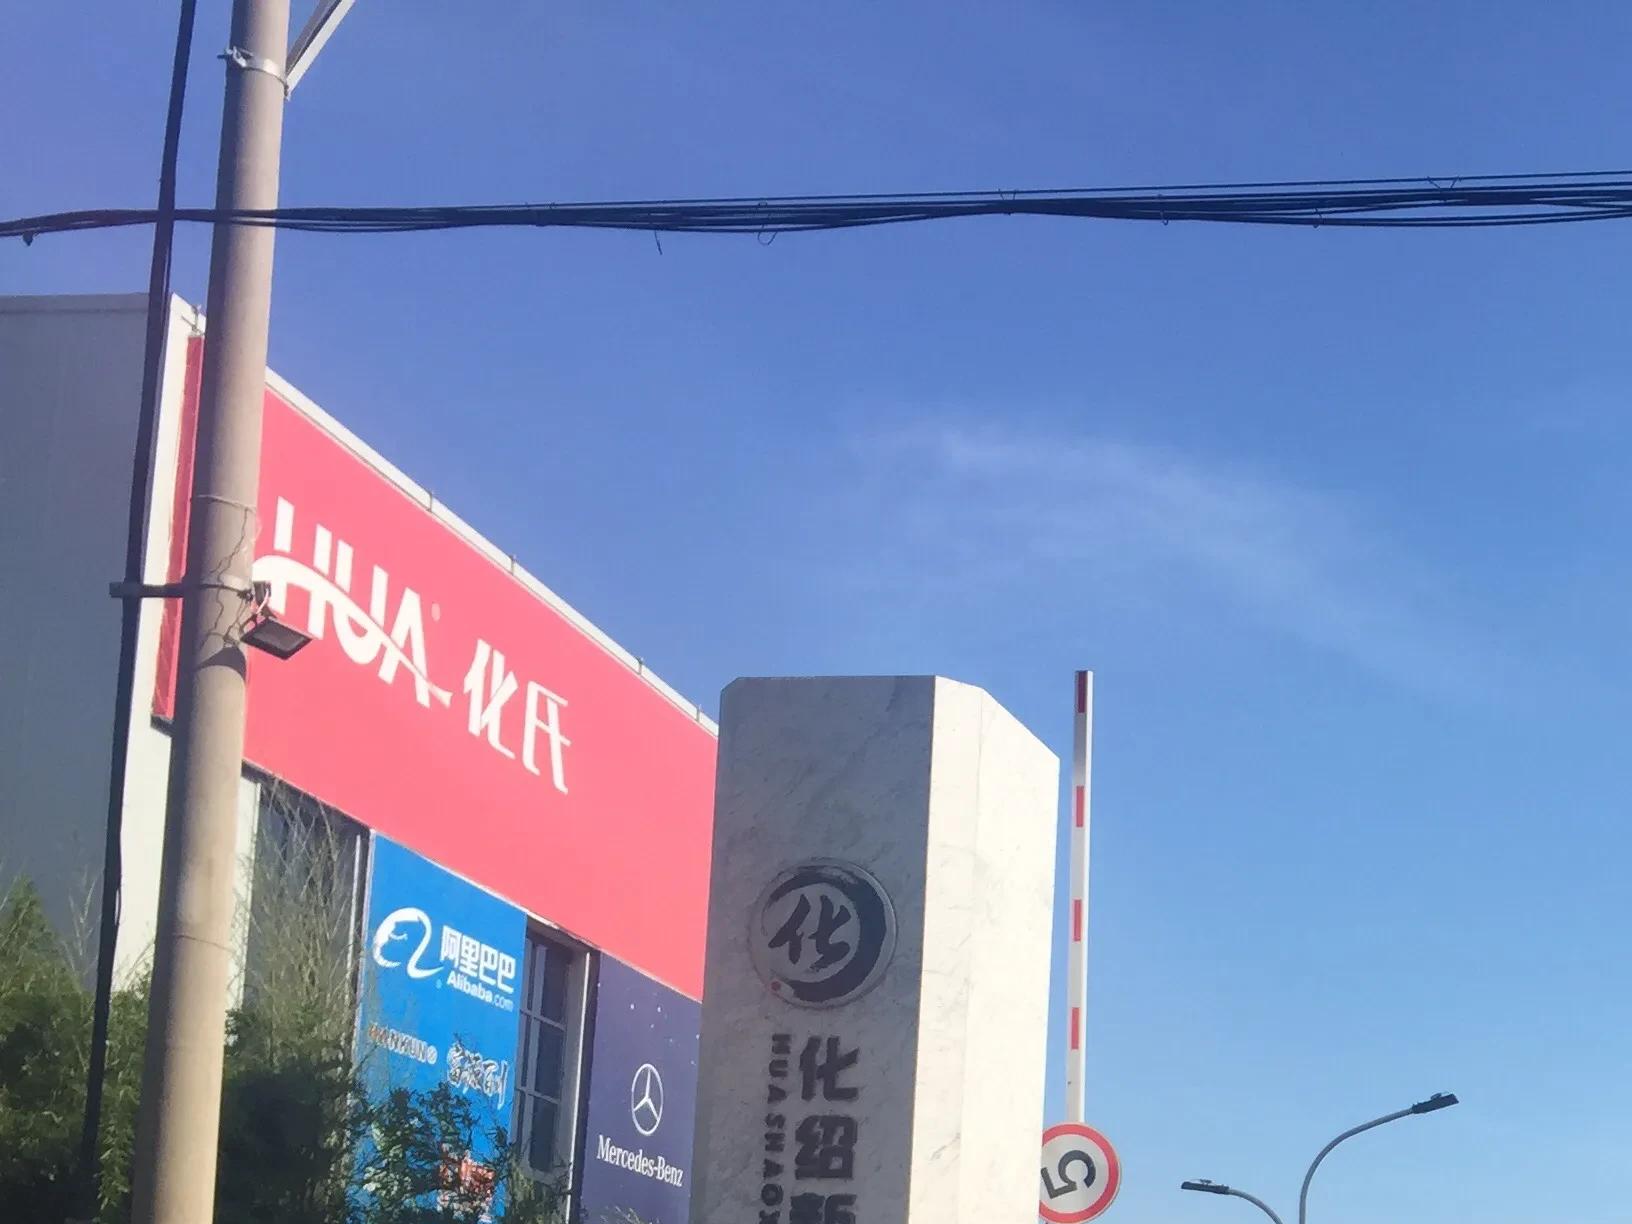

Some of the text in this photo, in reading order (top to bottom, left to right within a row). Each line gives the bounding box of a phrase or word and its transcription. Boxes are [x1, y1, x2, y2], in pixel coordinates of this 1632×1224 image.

[464, 638, 571, 794] 化氏
[440, 925, 516, 994] 阿里巴巴
[767, 893, 852, 973] 化
[446, 970, 514, 1012] Alibaba.com
[596, 1133, 684, 1188] Mercedes-Benz
[1040, 1149, 1097, 1200] 5
